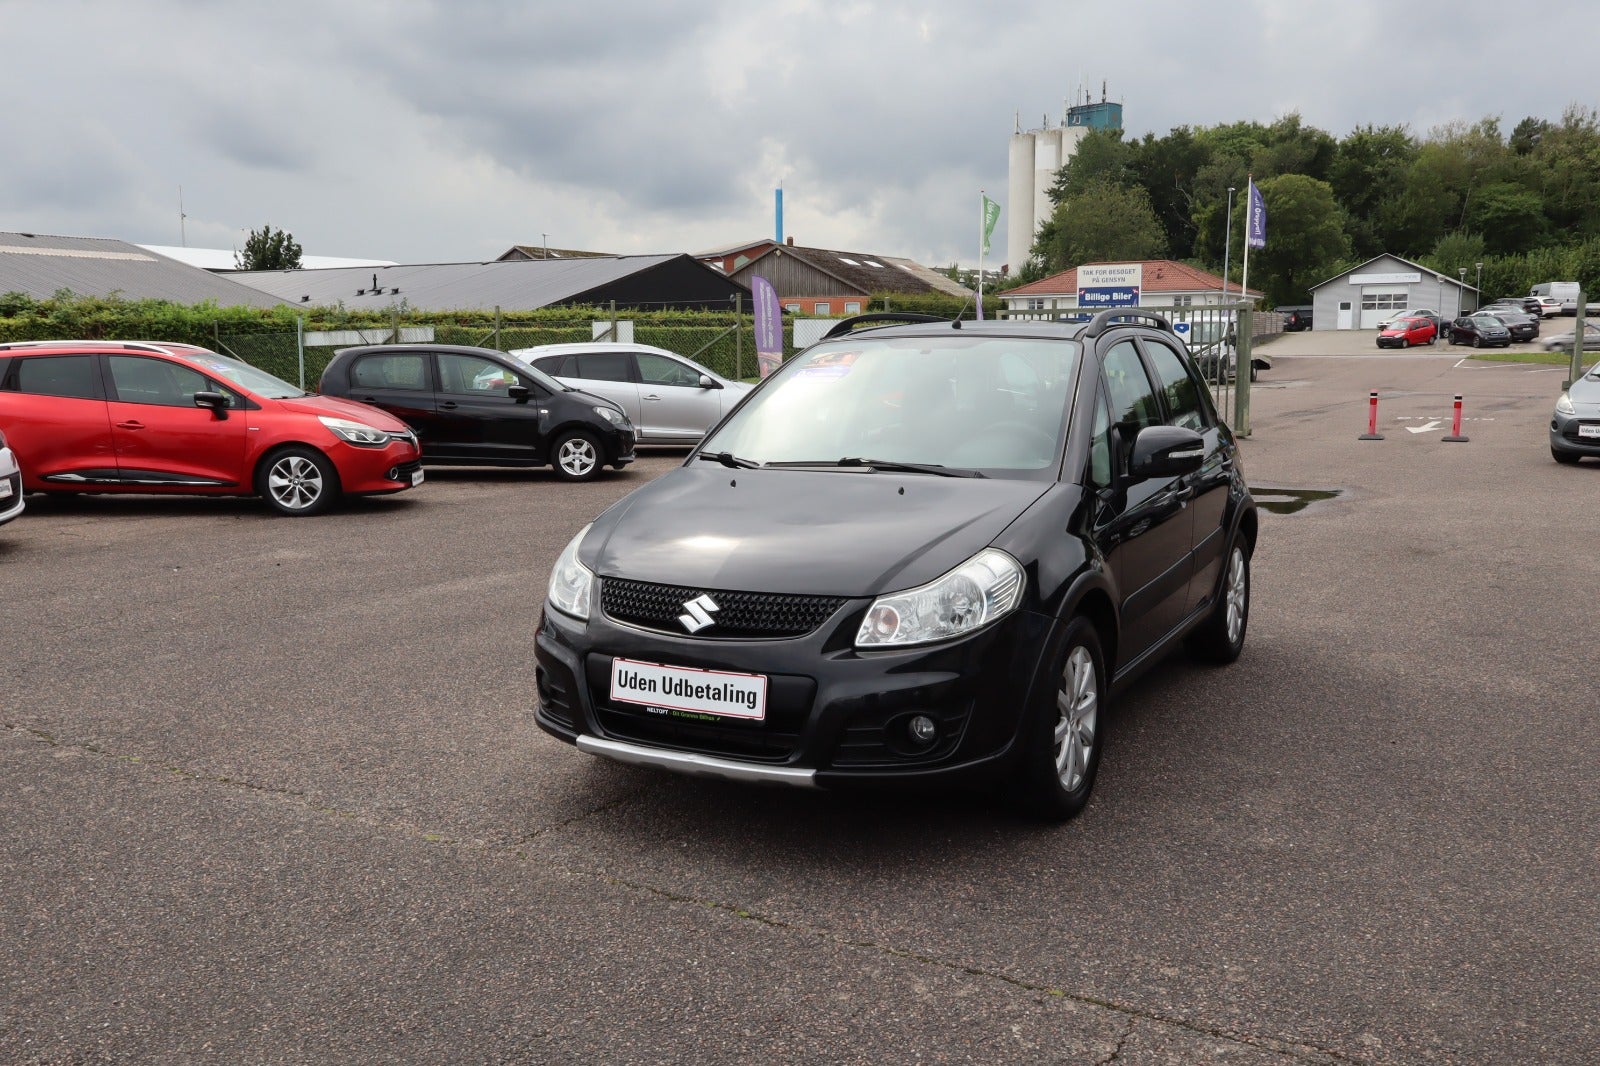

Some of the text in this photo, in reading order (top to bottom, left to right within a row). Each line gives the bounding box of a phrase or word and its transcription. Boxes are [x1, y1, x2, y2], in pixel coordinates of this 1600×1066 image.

[1112, 292, 1132, 300] Biler
[618, 669, 757, 709] Uden Udbetaling
[646, 707, 669, 715] NELTOFT
